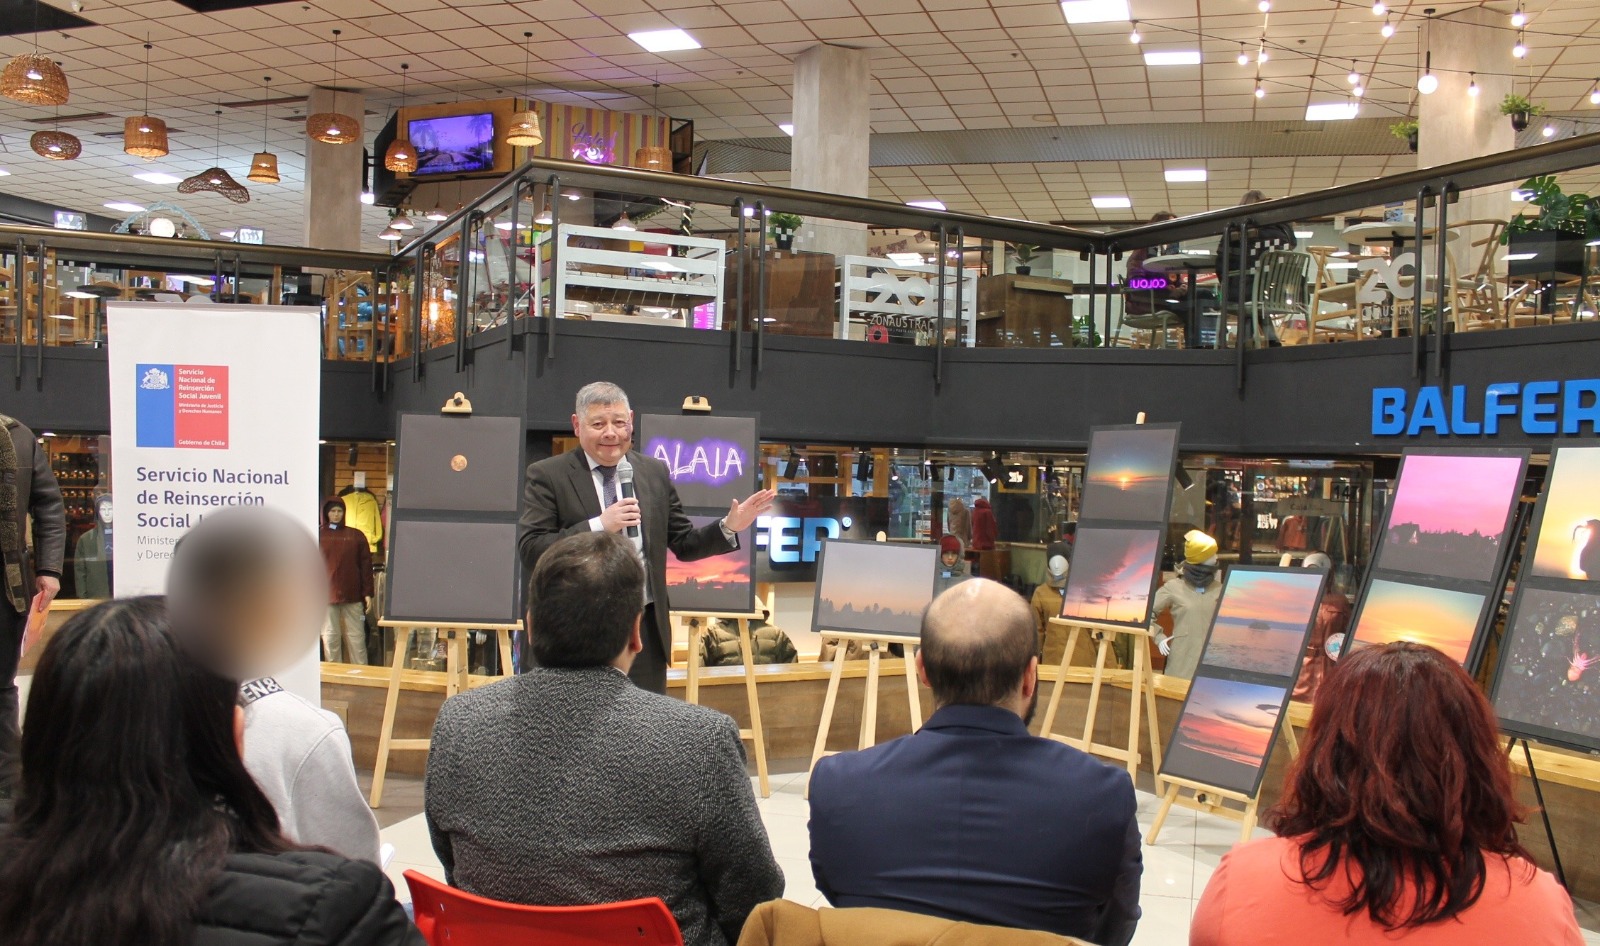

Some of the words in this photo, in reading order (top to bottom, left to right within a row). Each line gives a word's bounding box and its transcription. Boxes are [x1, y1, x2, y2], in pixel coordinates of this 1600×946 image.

[178, 384, 215, 392] Reinserción
[1372, 378, 1600, 435] BALFER
[136, 466, 208, 483] Servicio
[213, 468, 290, 485] Nacional
[137, 490, 158, 505] de
[164, 490, 265, 507] Reinserción
[137, 512, 191, 528] Social
[137, 551, 143, 562] y
[145, 550, 175, 560] Derec
